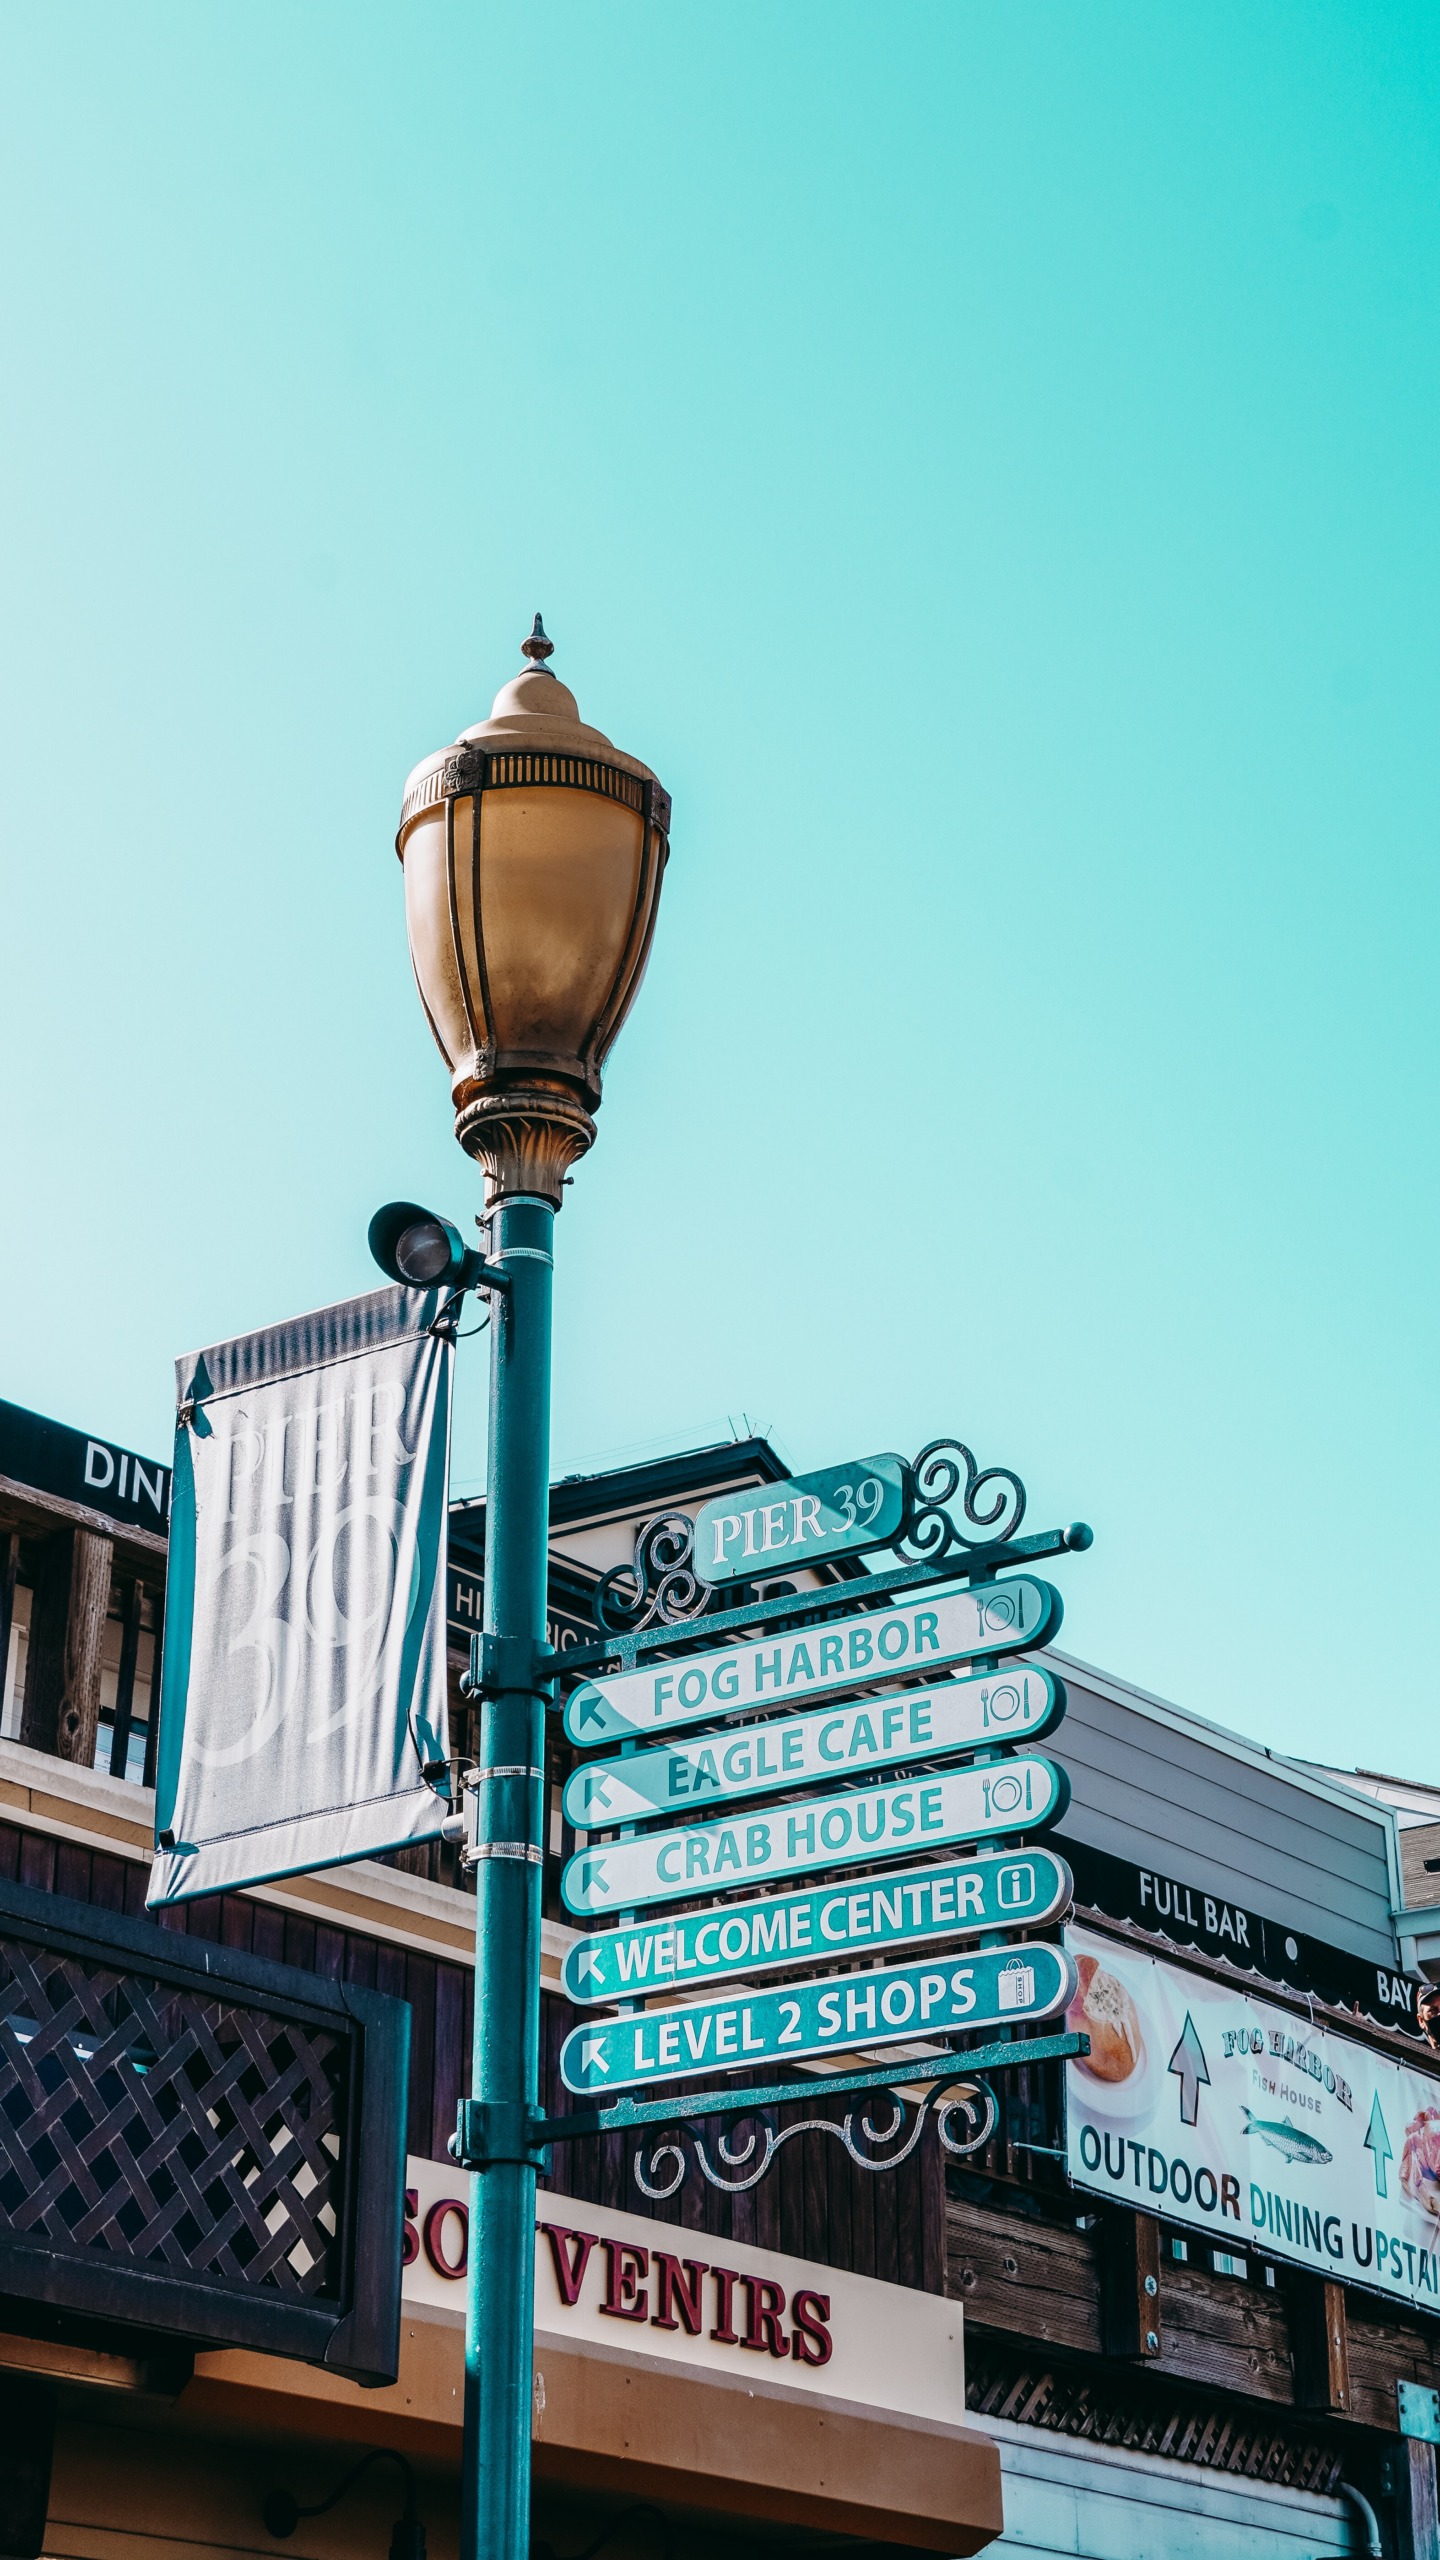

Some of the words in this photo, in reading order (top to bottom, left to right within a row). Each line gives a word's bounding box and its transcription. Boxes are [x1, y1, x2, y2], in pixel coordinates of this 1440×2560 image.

[219, 1381, 417, 1521] PIER
[711, 1494, 827, 1564] PIER
[832, 1477, 885, 1532] 39
[191, 1496, 421, 1767] 39
[653, 1658, 739, 1716] FOG
[755, 1611, 939, 1693] HARBOR
[668, 1728, 804, 1797] EAGLE
[818, 1700, 933, 1762] CAFE
[656, 1822, 771, 1884] CRAB
[787, 1786, 944, 1858] HOUSE
[615, 1907, 812, 1981] WELCOME
[819, 1874, 985, 1941] CENTER
[1139, 1871, 1199, 1930] FULL
[1204, 1904, 1250, 1948] BAR
[1376, 1970, 1413, 2012] BAY
[634, 2006, 765, 2070] LEVEL
[778, 2000, 801, 2044] 2
[817, 1968, 976, 2036] SHOPS
[1221, 2027, 1265, 2058] FOG
[1268, 2030, 1354, 2113] HARBOR
[1080, 2124, 1241, 2221] OUTDOOR
[1249, 2182, 1344, 2258] DINING
[1352, 2215, 1440, 2294] UPSTAI
[402, 2187, 833, 2367] OVENIRS
